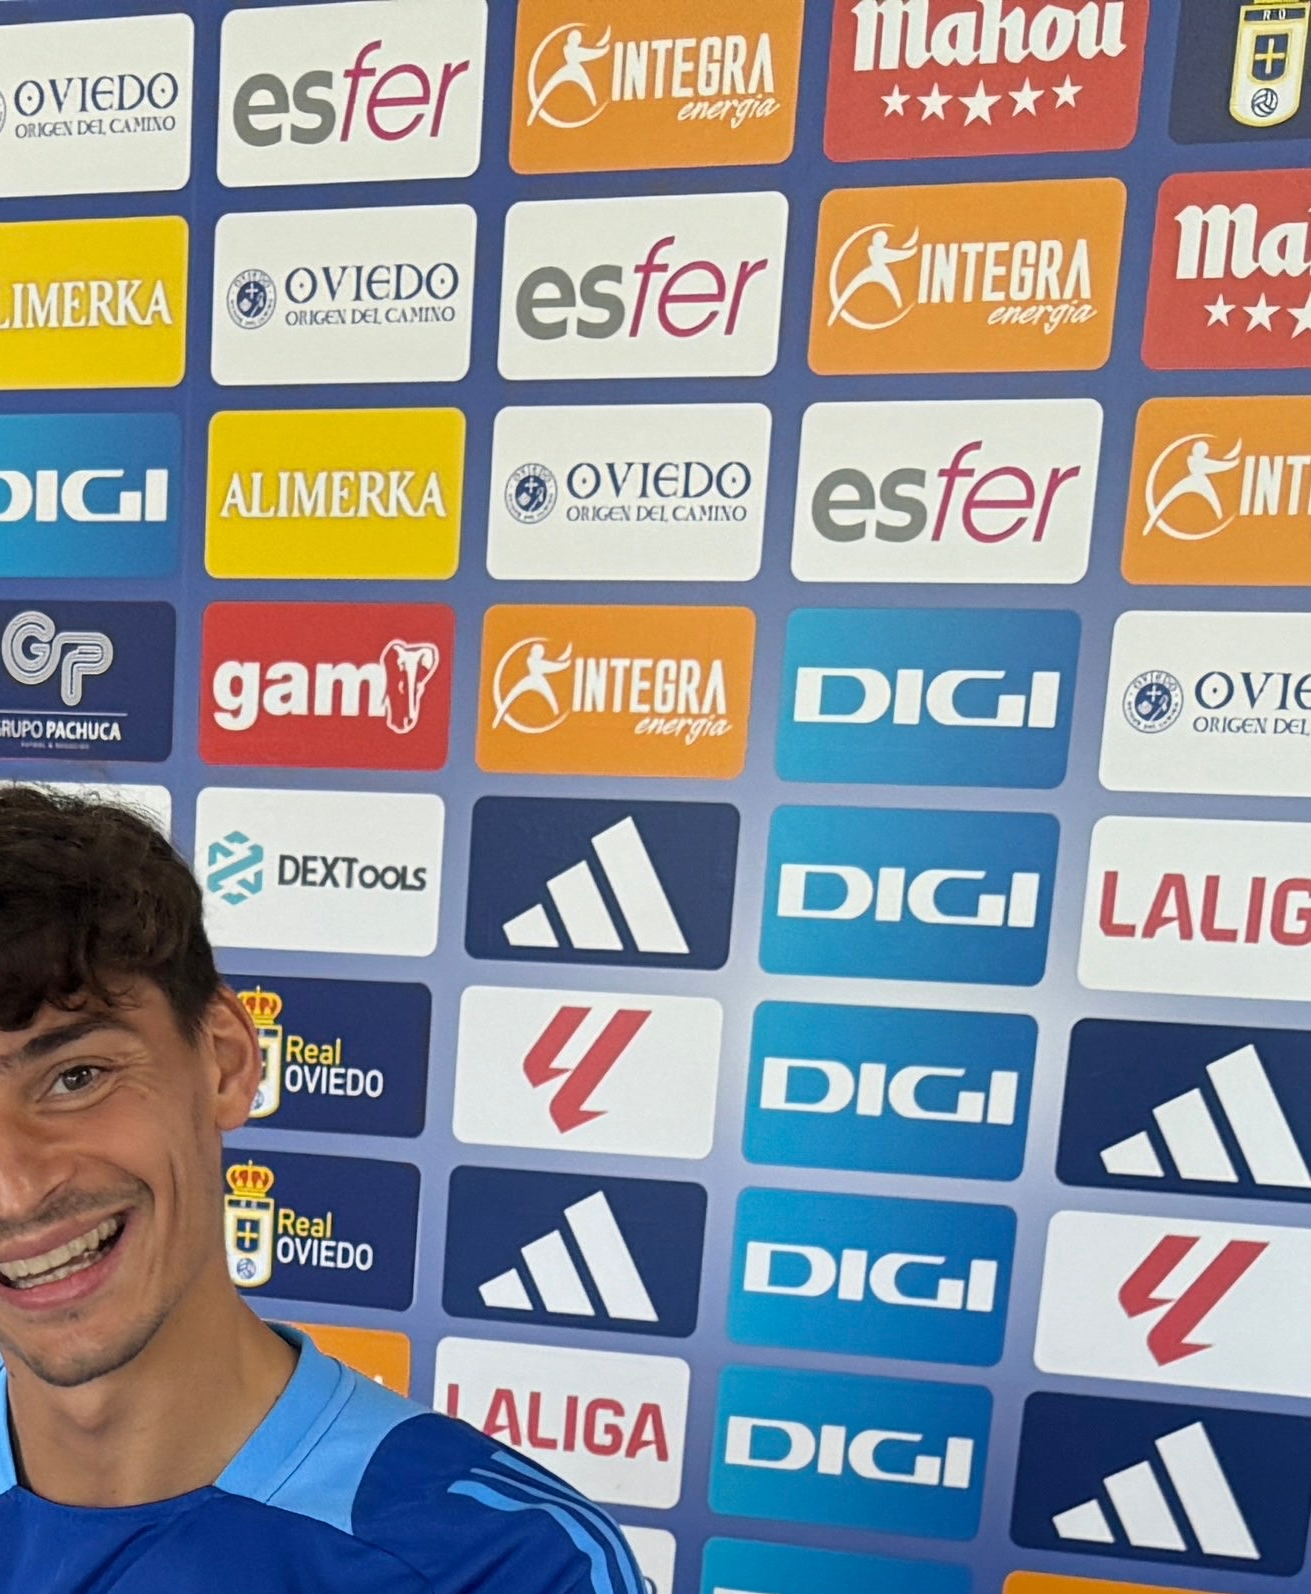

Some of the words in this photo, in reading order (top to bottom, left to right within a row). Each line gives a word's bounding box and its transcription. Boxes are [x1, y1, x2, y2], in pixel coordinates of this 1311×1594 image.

[851, 0, 1128, 72] Mahou
[14, 72, 178, 116] OVIEDO
[232, 40, 470, 147] esfer
[610, 32, 774, 102] INTEGRA
[15, 121, 73, 138] ORIGEN
[78, 119, 106, 136] DEL
[109, 115, 176, 134] CAMINO
[917, 238, 1092, 304] INTEGRA
[1174, 203, 1311, 280] Ma
[285, 262, 459, 303] OVIEDO
[515, 235, 768, 340] esfer
[285, 306, 345, 326] ORIGEN
[351, 306, 381, 325] DEL
[386, 304, 455, 324] CAMINO
[220, 471, 446, 520] ALIMERKA
[566, 461, 752, 500] OVIEDO
[811, 440, 1081, 543] esfer
[1239, 455, 1311, 516] INT
[566, 505, 630, 523] ORIGEN
[636, 505, 667, 523] DEL
[672, 504, 747, 523] CAMINO
[213, 660, 388, 732] gam
[572, 657, 726, 715] INTEGRA
[793, 667, 1061, 729] DIGI
[46, 721, 121, 741] PACHUCA
[1193, 716, 1268, 734] ORIGEN
[1273, 718, 1311, 736] DEL
[777, 863, 1040, 928] DIGI
[286, 1035, 342, 1066] Real
[285, 1064, 383, 1099] OVIEDO
[760, 1056, 1018, 1125] DIGI
[278, 1208, 332, 1239] Real
[276, 1236, 373, 1271] OVIEDO
[743, 1241, 998, 1313] DIGI
[725, 1415, 974, 1489] DIGI
